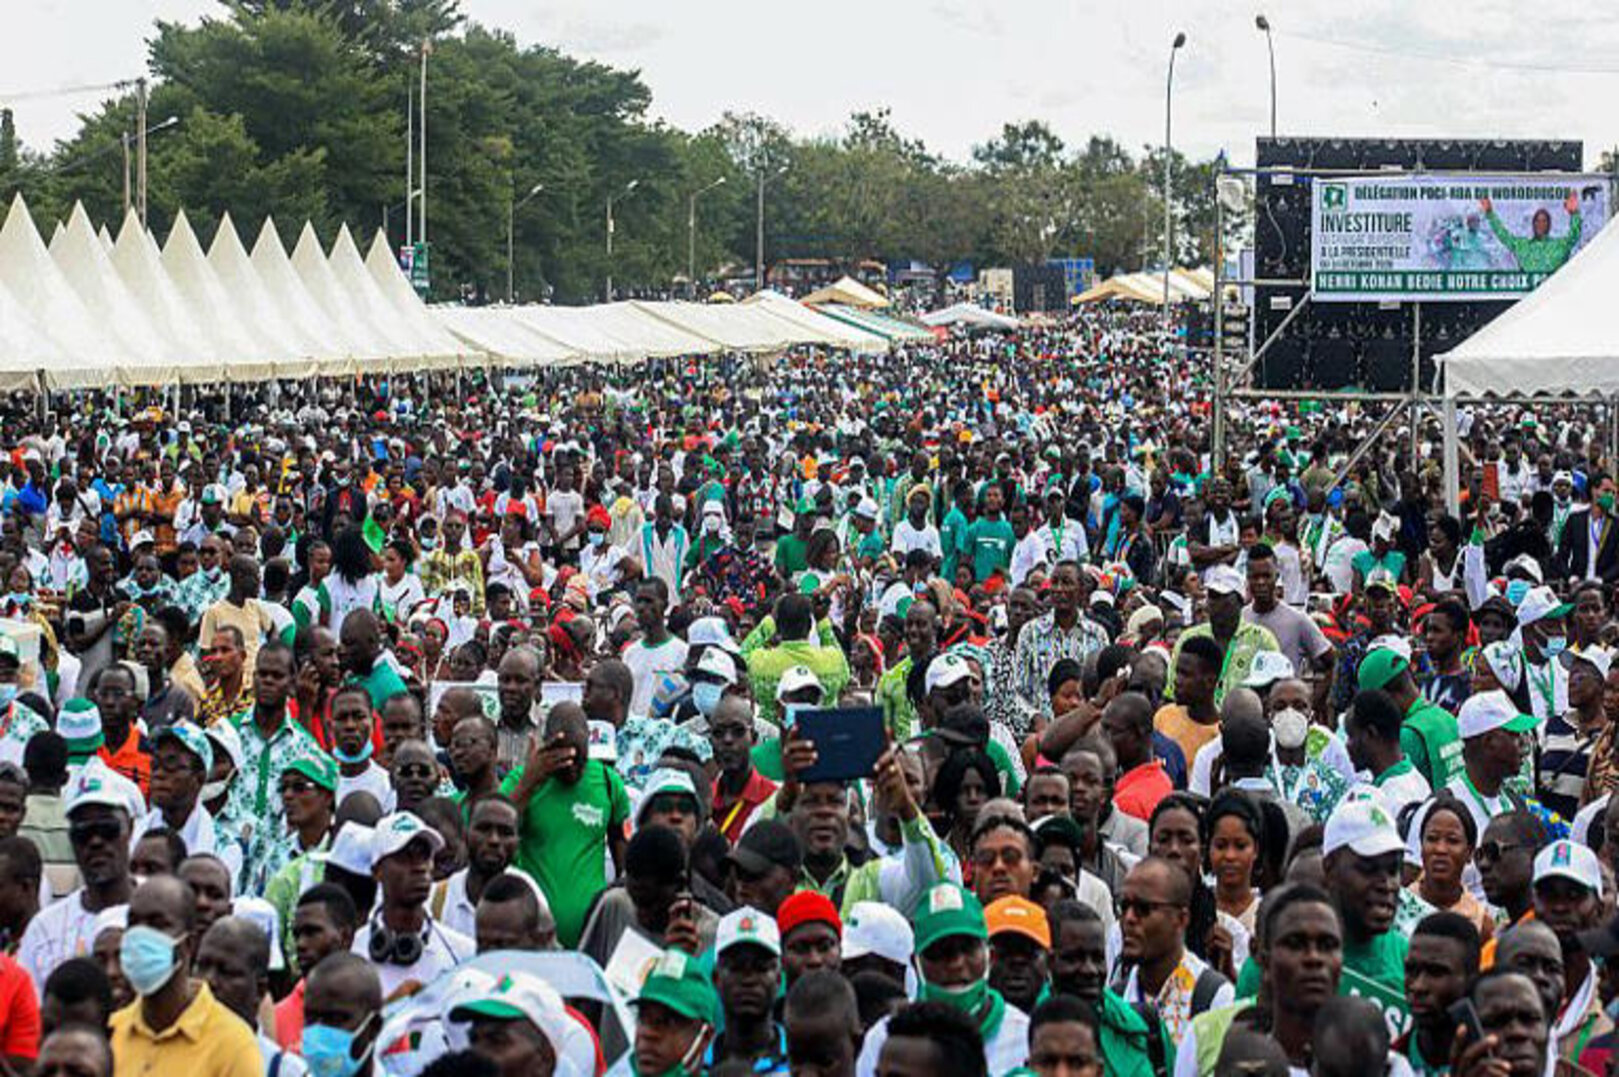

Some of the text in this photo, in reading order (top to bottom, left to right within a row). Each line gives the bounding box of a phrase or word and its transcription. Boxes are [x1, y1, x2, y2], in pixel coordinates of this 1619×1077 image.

[1321, 213, 1413, 233] INVESTITURE
[1319, 272, 1357, 290] HENRI
[1447, 272, 1488, 289] NOTRE
[1491, 272, 1529, 289] CHOIX
